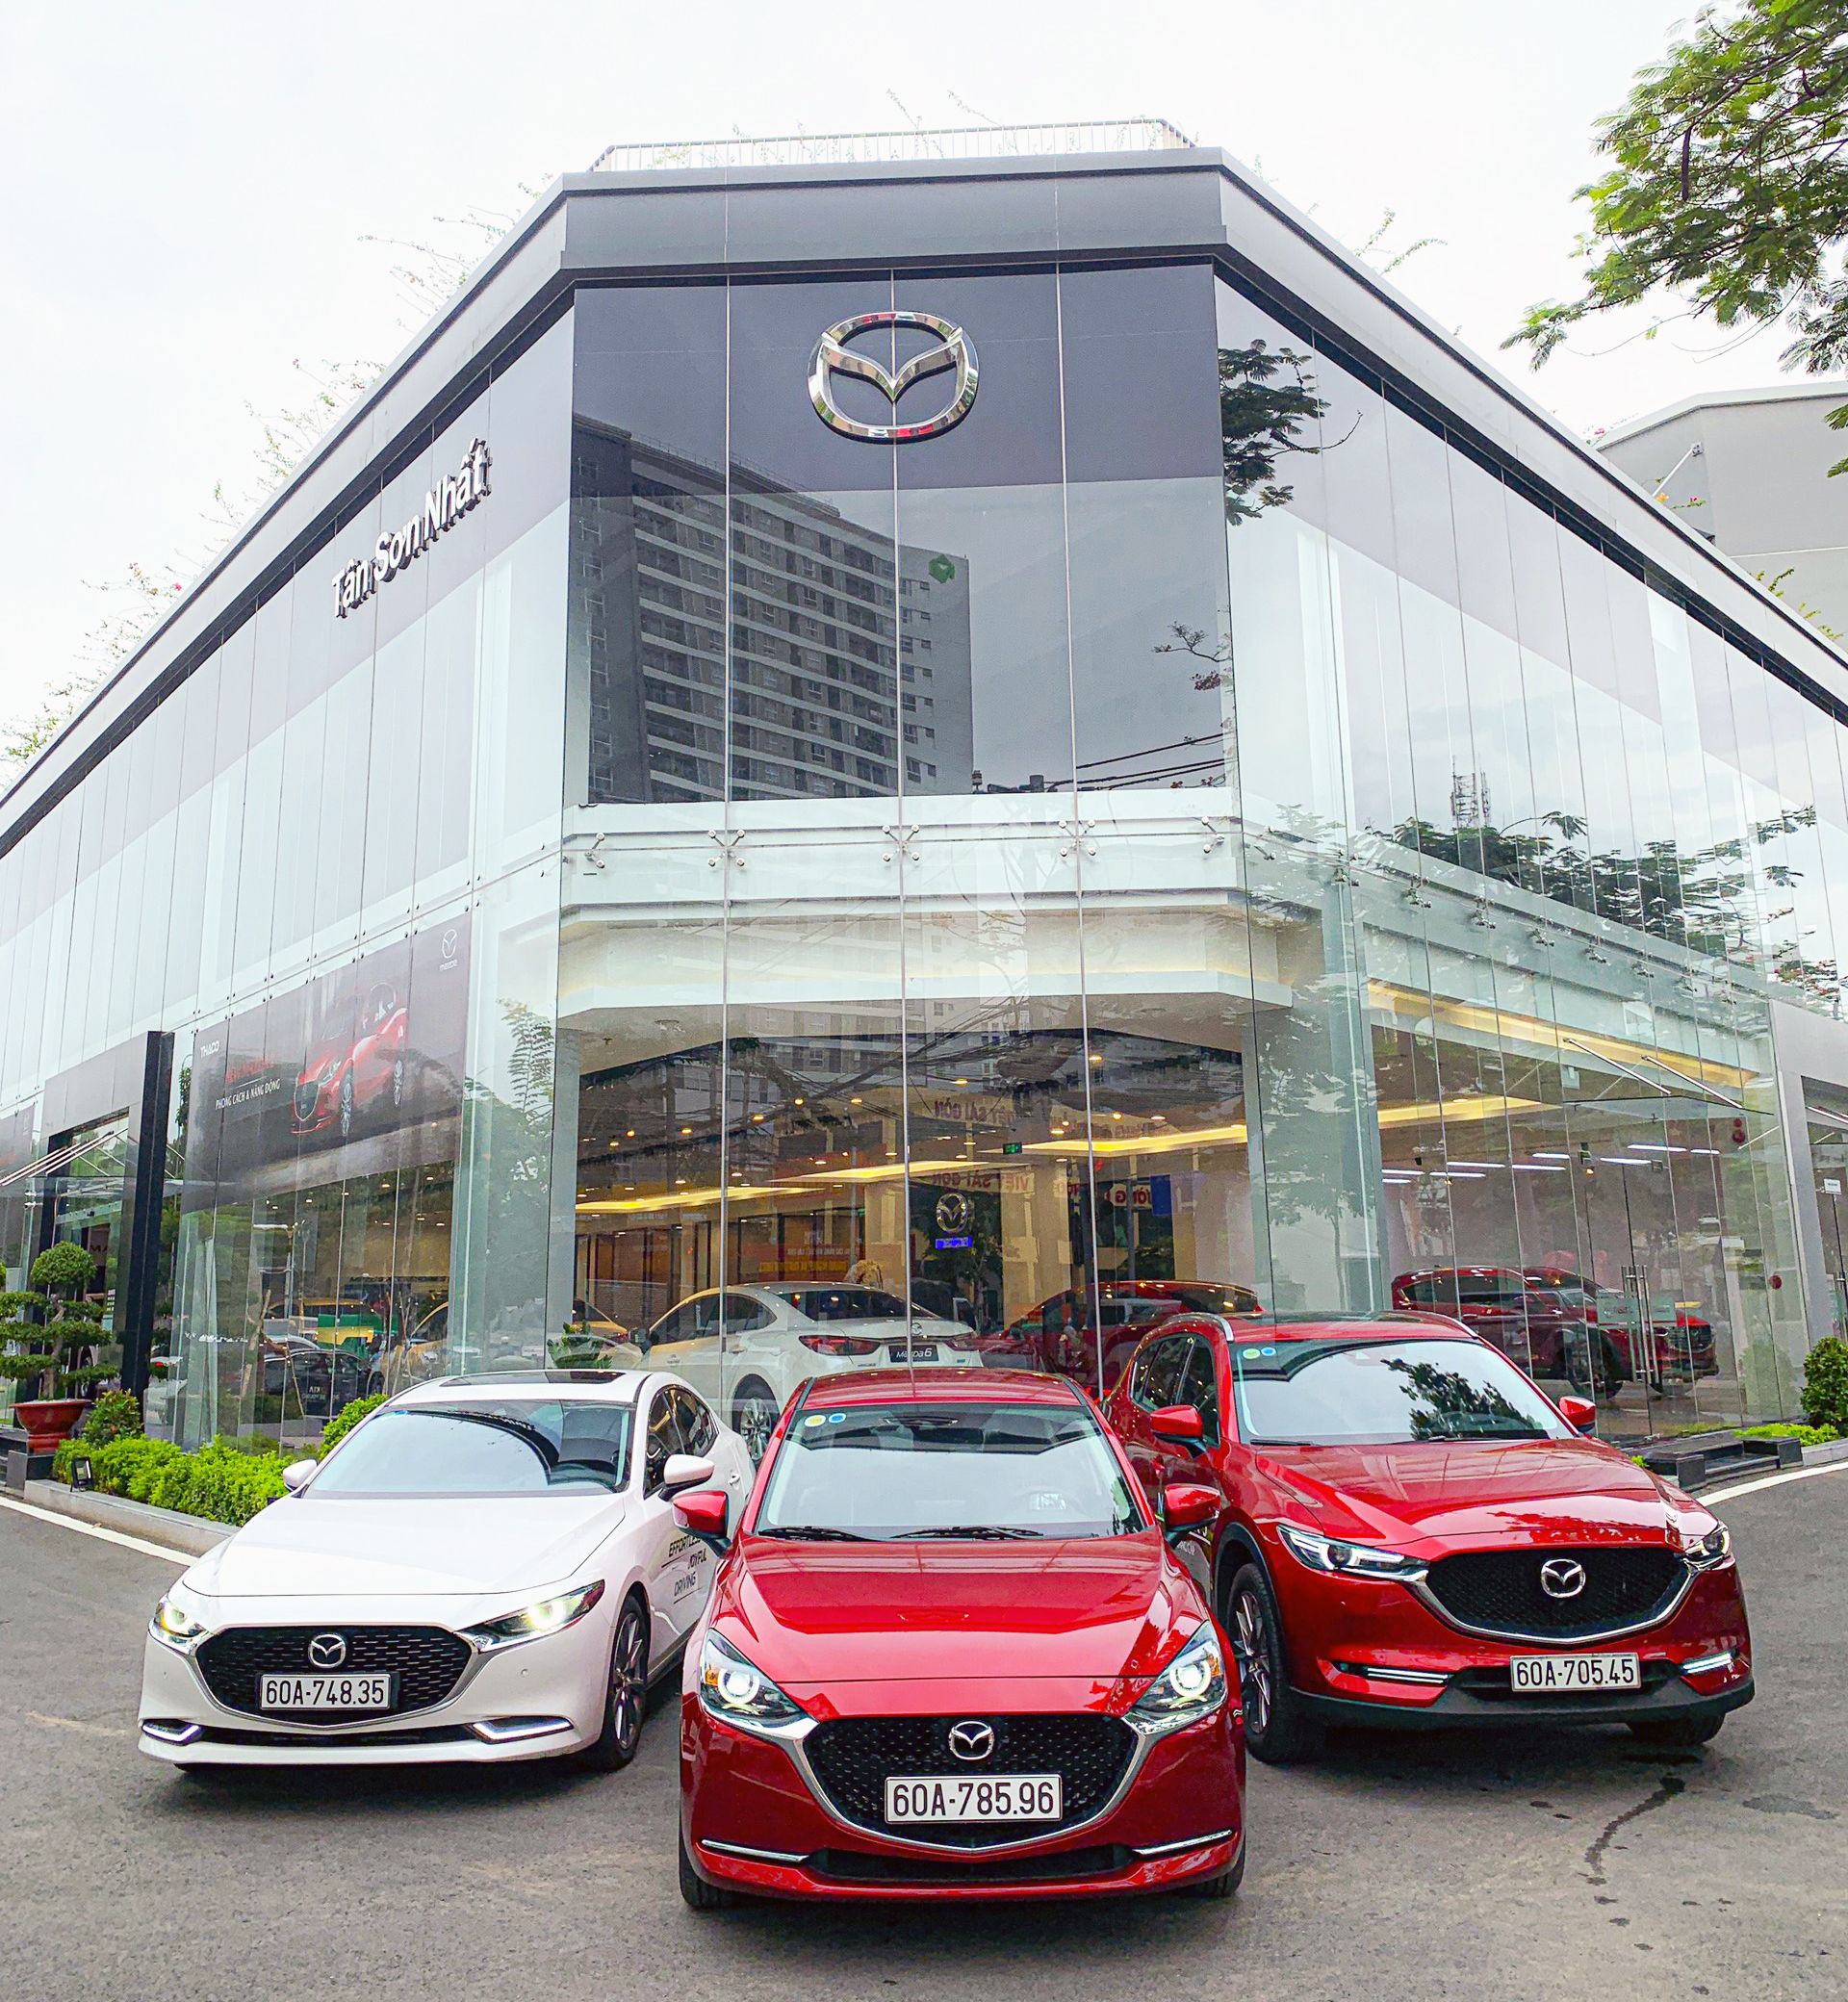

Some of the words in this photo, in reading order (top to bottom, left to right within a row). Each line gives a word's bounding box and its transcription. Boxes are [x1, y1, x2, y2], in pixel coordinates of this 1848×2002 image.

[332, 557, 375, 618] Tân
[373, 515, 426, 582] Sơn
[423, 438, 493, 542] Nhất
[199, 1040, 220, 1059] THACO
[215, 1095, 232, 1111] PHONG
[674, 1570, 696, 1597] DRIVING
[1516, 1658, 1634, 1686] 60A-705.45
[266, 1680, 384, 1705] 60A-748.35
[893, 1782, 1054, 1816] 60A-785.96
